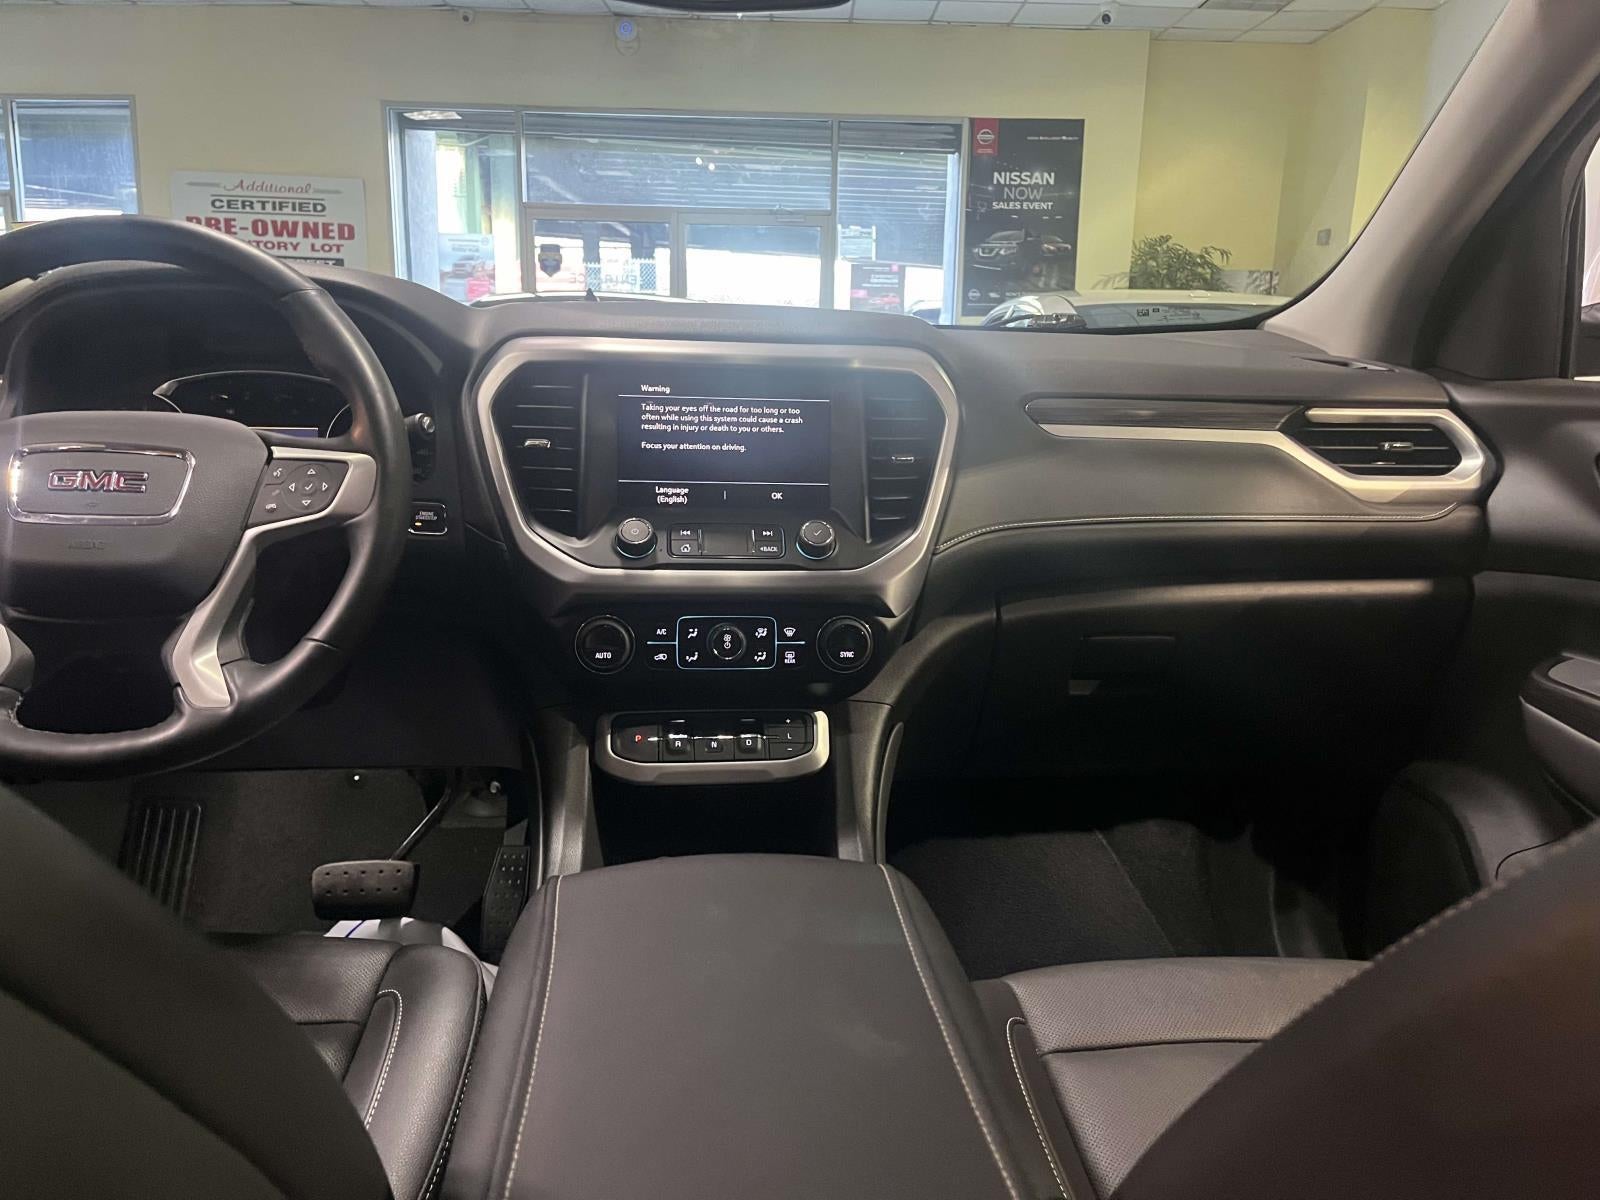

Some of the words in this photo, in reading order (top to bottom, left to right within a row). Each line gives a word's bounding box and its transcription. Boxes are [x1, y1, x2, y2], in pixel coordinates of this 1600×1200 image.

[993, 171, 1055, 185] NISSAN
[223, 179, 312, 194] Additional
[1003, 186, 1043, 200] NOW
[211, 198, 327, 213] CERTIFIED
[992, 201, 1021, 210] SALES
[1022, 201, 1053, 210] EVENT
[311, 242, 344, 253] LOT
[641, 384, 671, 394] Warning
[641, 403, 664, 413] Taking
[665, 405, 680, 413] your
[682, 405, 697, 413] eyes
[699, 404, 709, 412] off
[709, 405, 721, 413] the
[722, 405, 738, 413] road
[764, 406, 778, 415] long
[661, 413, 679, 421] while
[680, 414, 699, 423] using
[700, 414, 713, 422] this
[714, 415, 737, 424] system
[739, 415, 757, 423] could
[784, 416, 803, 424] crash
[641, 422, 671, 432] resulting
[672, 423, 680, 431] in
[680, 424, 699, 433] injury
[708, 424, 729, 432] death
[738, 426, 751, 434] you
[760, 425, 784, 433] others.
[641, 441, 662, 449] Focus
[663, 443, 678, 451] your
[679, 442, 711, 450] attention
[721, 443, 747, 452] driving.
[47, 468, 149, 494] GMC
[655, 485, 689, 495] Language
[657, 495, 688, 505] (English)
[771, 492, 783, 500] OK
